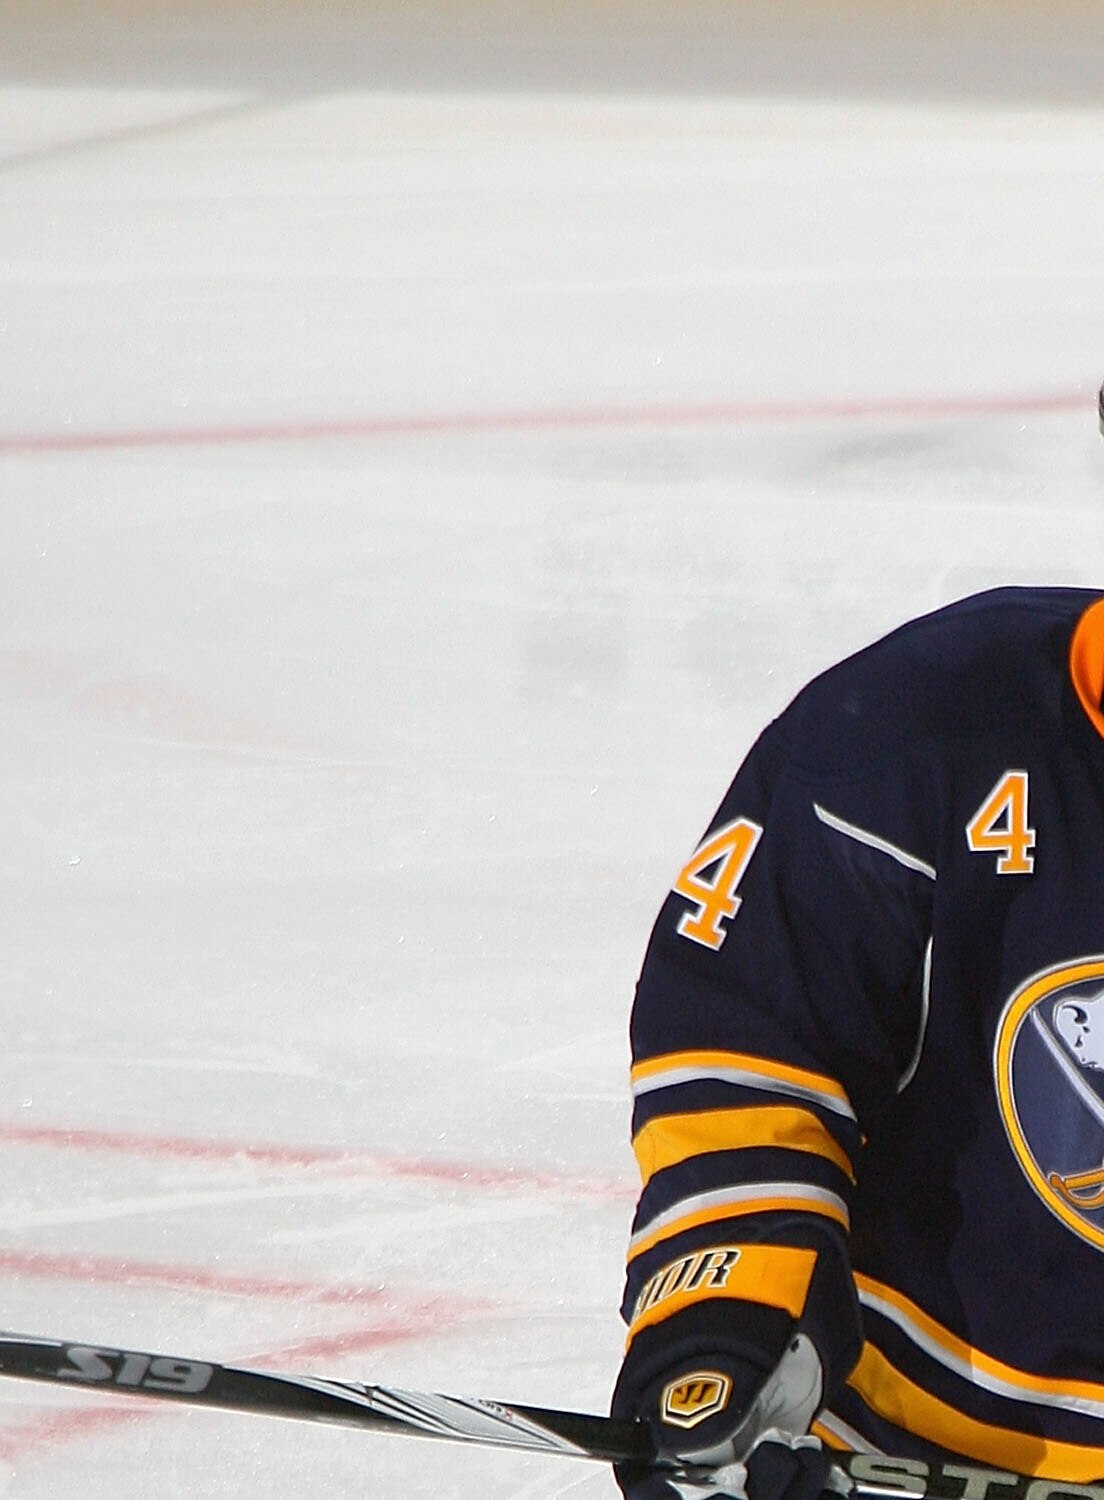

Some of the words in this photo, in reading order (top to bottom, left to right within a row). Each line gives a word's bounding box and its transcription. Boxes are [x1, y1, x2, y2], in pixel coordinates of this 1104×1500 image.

[967, 769, 1036, 875] 4
[671, 816, 764, 952] 4
[630, 1247, 742, 1325] IOR
[56, 1346, 214, 1394] S19
